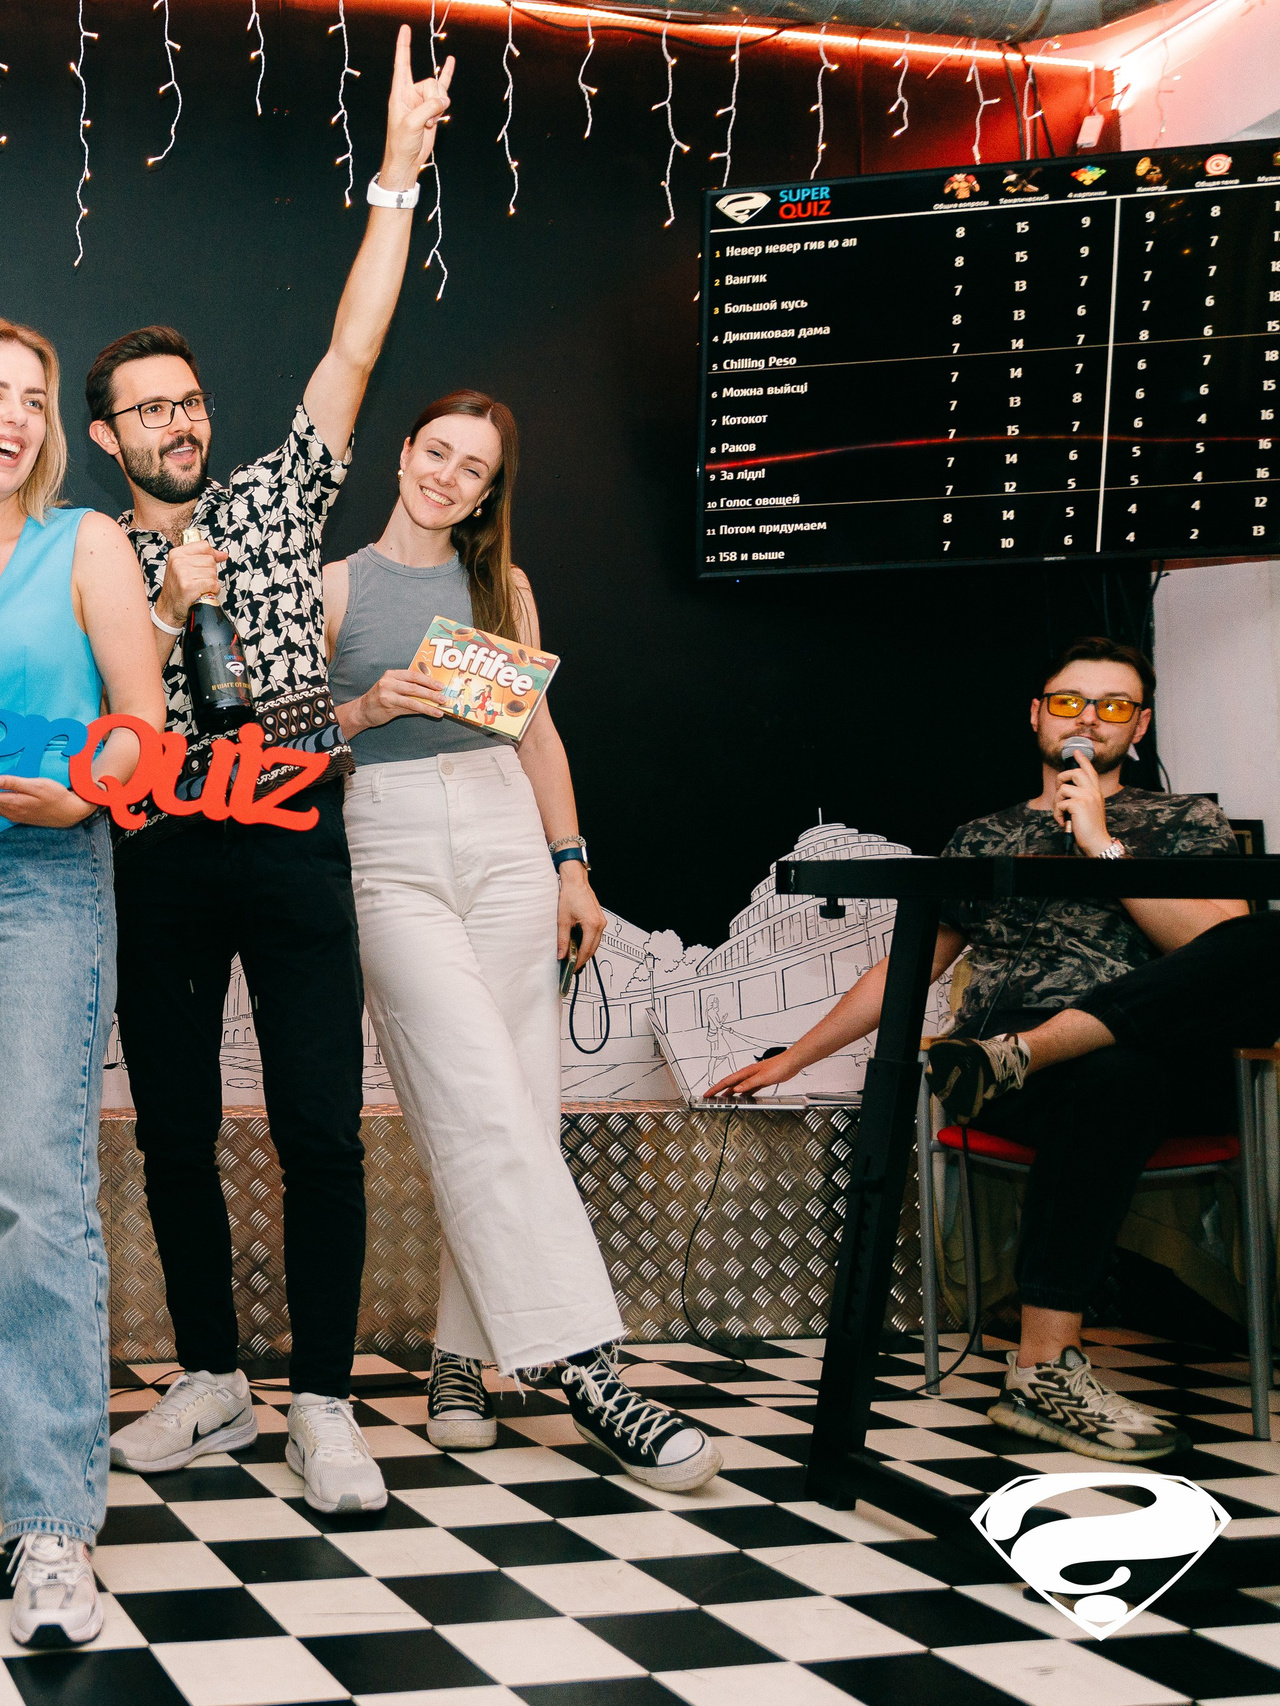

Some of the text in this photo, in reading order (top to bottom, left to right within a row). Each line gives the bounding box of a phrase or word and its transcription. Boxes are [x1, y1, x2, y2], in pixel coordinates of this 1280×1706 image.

[779, 186, 831, 203] SUPER
[779, 199, 831, 220] QUIZ
[714, 250, 721, 259] 1
[726, 246, 762, 257] Невер
[765, 243, 801, 254] невер
[804, 241, 825, 250] гив
[828, 240, 839, 249] ю
[842, 238, 857, 248] ап
[955, 226, 966, 239] 8
[1015, 221, 1030, 234] 15
[1081, 216, 1091, 228] 9
[1145, 210, 1156, 223] 9
[1210, 205, 1221, 218] 8
[714, 278, 721, 287] 2
[725, 274, 767, 285] Вангик
[954, 255, 965, 268] 8
[1014, 250, 1029, 263] 15
[1079, 245, 1090, 258] 9
[1145, 240, 1154, 253] 7
[1209, 235, 1219, 247] 7
[713, 306, 720, 315] 3
[725, 300, 777, 314] Большой
[781, 300, 808, 312] кусь
[954, 284, 963, 297] 7
[1014, 279, 1027, 292] 13
[1079, 275, 1089, 287] 7
[1143, 270, 1153, 282] 7
[1208, 265, 1217, 277] 7
[712, 335, 720, 344] 4
[798, 326, 830, 339] дама
[951, 313, 962, 326] 8
[1012, 309, 1026, 321] 13
[1076, 304, 1087, 317] 6
[1141, 299, 1151, 312] 7
[1204, 295, 1215, 307] 6
[1268, 290, 1280, 302] 18
[711, 319, 1280, 371] 5 Chilling Peso 7 14 7 8 6 15
[711, 349, 1280, 399] 6 Можна выйсці 7 14 7 6 7 18
[711, 379, 1277, 427] 7 Котокот 7 13 8 6 6 15
[709, 408, 1275, 454] 8 Раков 7 15 7 6 4 16
[709, 474, 716, 482] 9
[720, 471, 734, 481] За
[946, 456, 955, 468] 7
[1004, 453, 1018, 465] 14
[1068, 449, 1079, 461] 6
[1131, 445, 1141, 458] 5
[1195, 442, 1205, 454] 5
[1257, 437, 1272, 450] 16
[706, 467, 1270, 509] 10 Голос овощей 7 12 5 5 4 16
[706, 496, 1268, 536] 11 Потом придумаем 8 14 5 4 4 12
[705, 555, 716, 563] 12
[719, 552, 737, 561] 158
[752, 550, 785, 560] выше
[942, 540, 951, 552] 7
[1000, 537, 1015, 549] 10
[1063, 534, 1073, 546] 6
[1125, 531, 1136, 543] 4
[1189, 528, 1199, 540] 2
[1252, 525, 1265, 537] 13
[429, 637, 534, 696] Toffifee
